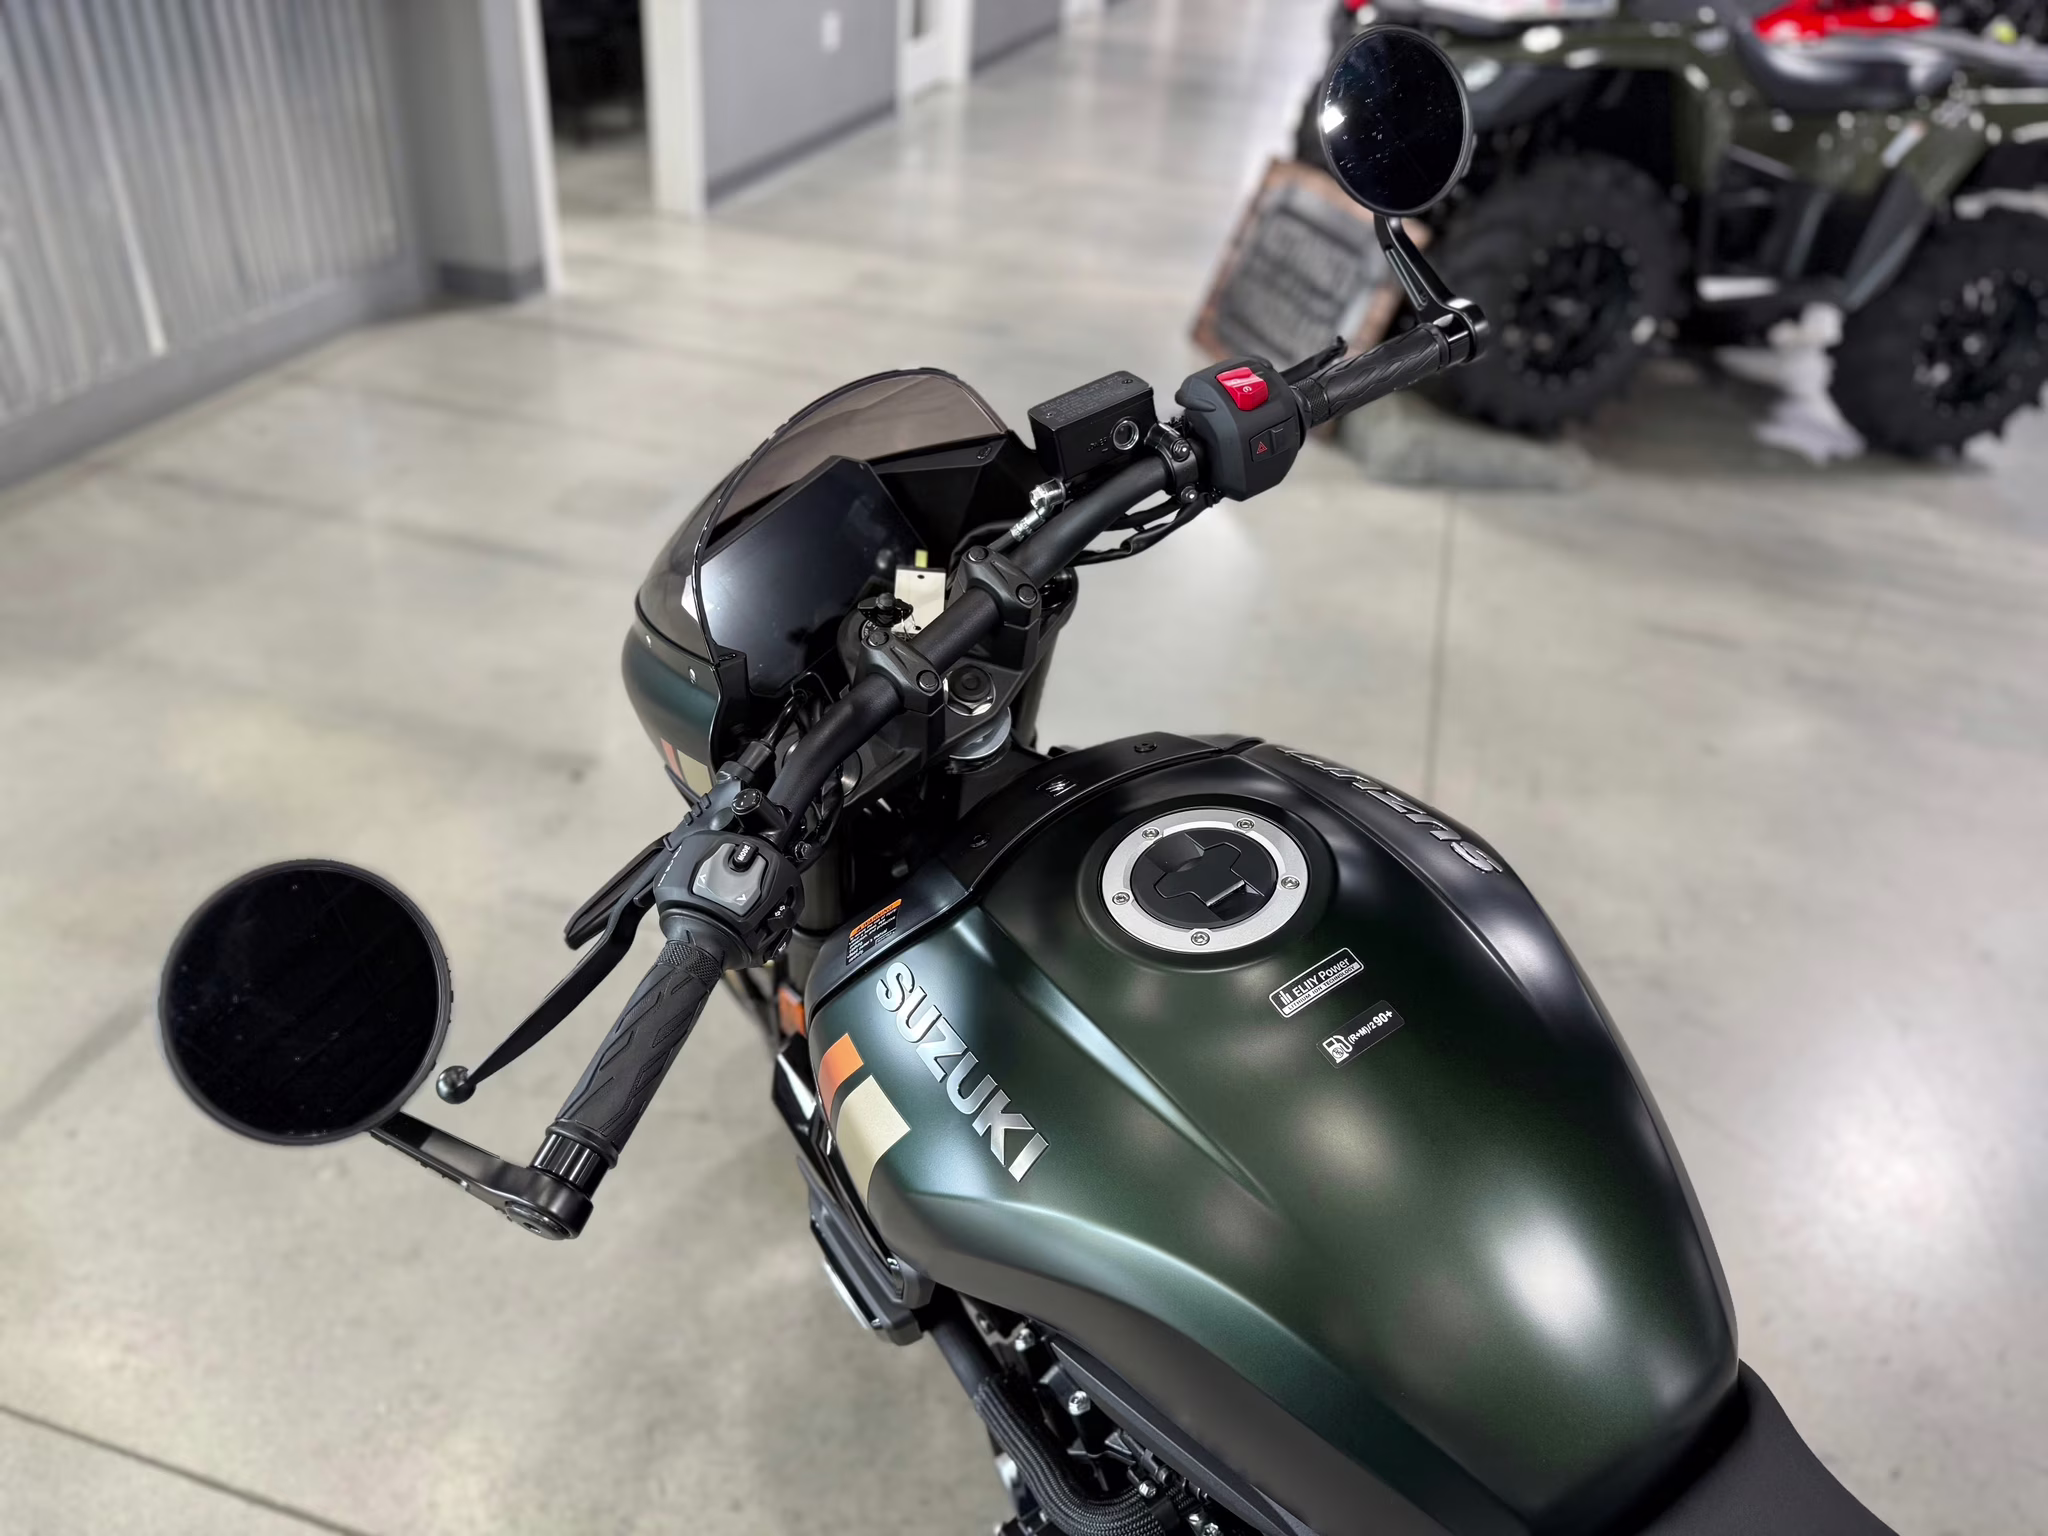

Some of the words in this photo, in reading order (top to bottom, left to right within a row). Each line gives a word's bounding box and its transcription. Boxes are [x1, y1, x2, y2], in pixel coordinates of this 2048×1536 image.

[737, 845, 750, 861] MODE
[1288, 993, 1312, 1011] LITHIUM
[1312, 986, 1323, 994] ION
[1323, 966, 1356, 987] TECHNOLOGY
[1292, 974, 1320, 998] ELIIY
[1318, 957, 1350, 981] Power
[1373, 1010, 1393, 1027] 90+
[876, 961, 1050, 1182] SUZUKI
